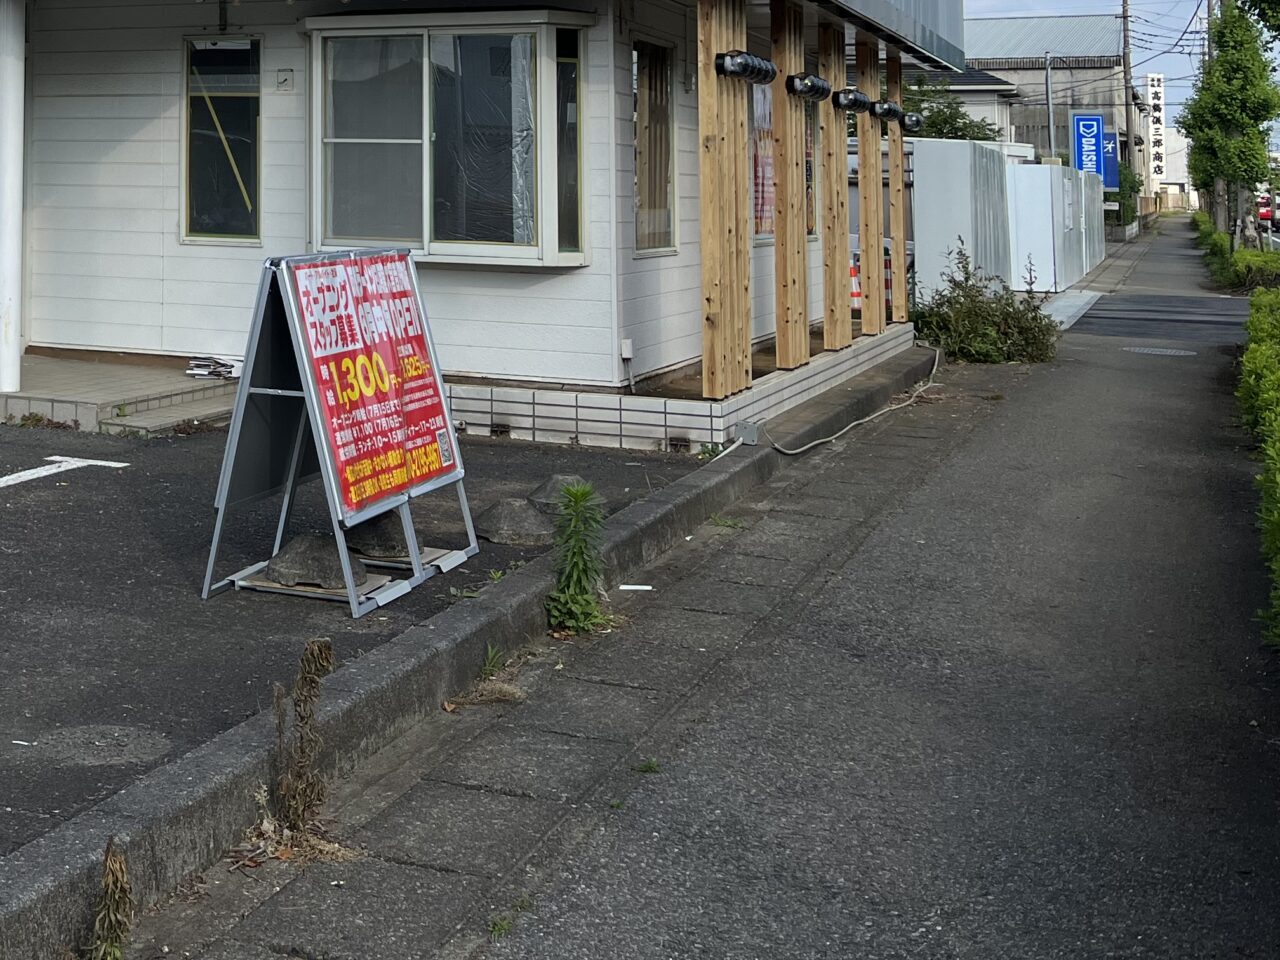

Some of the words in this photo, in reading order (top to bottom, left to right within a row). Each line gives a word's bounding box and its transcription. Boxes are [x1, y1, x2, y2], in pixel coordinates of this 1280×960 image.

[1081, 137, 1097, 175] DAISHI
[302, 280, 350, 317] オープニング
[310, 312, 360, 351] スタッフ募集
